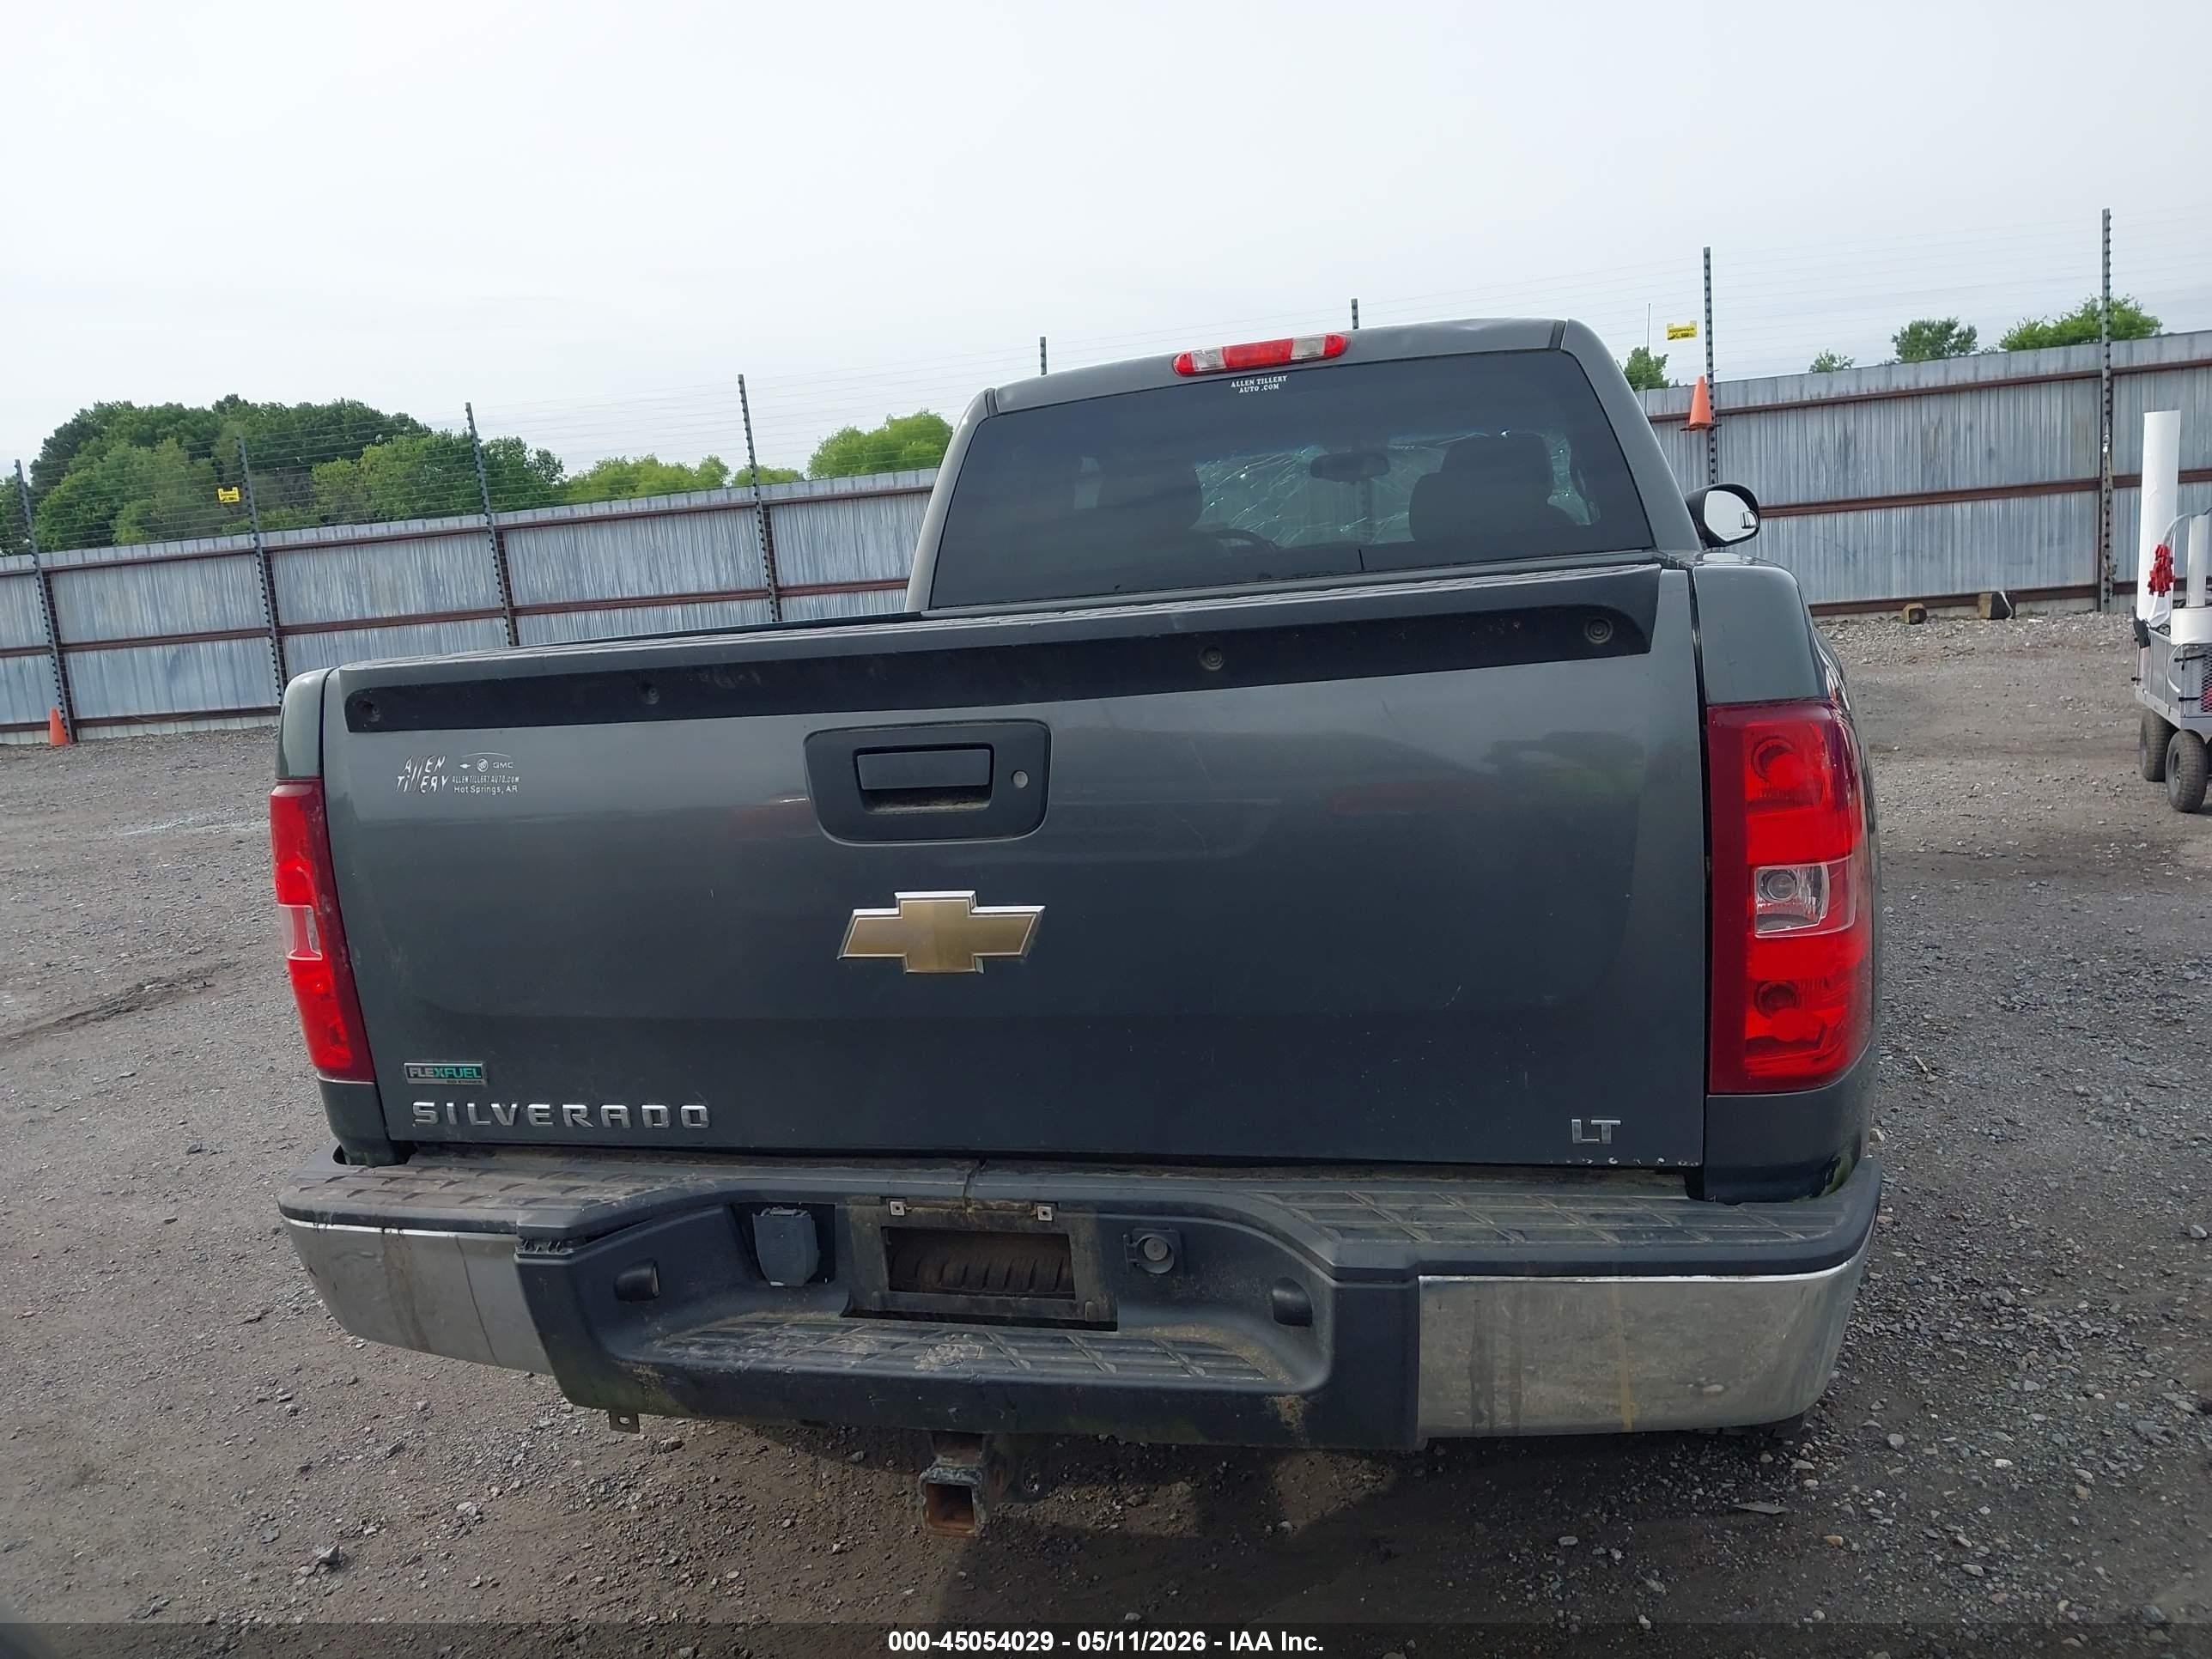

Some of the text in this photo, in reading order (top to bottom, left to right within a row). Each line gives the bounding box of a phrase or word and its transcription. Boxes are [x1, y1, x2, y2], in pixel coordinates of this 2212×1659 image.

[1256, 375, 1287, 385] TILLERY
[453, 785, 469, 793] Hot
[470, 785, 504, 795] Springs,
[408, 1066, 482, 1079] FLEXFUEL
[412, 1102, 710, 1128] SILVERADO
[1571, 1119, 1621, 1144] LT
